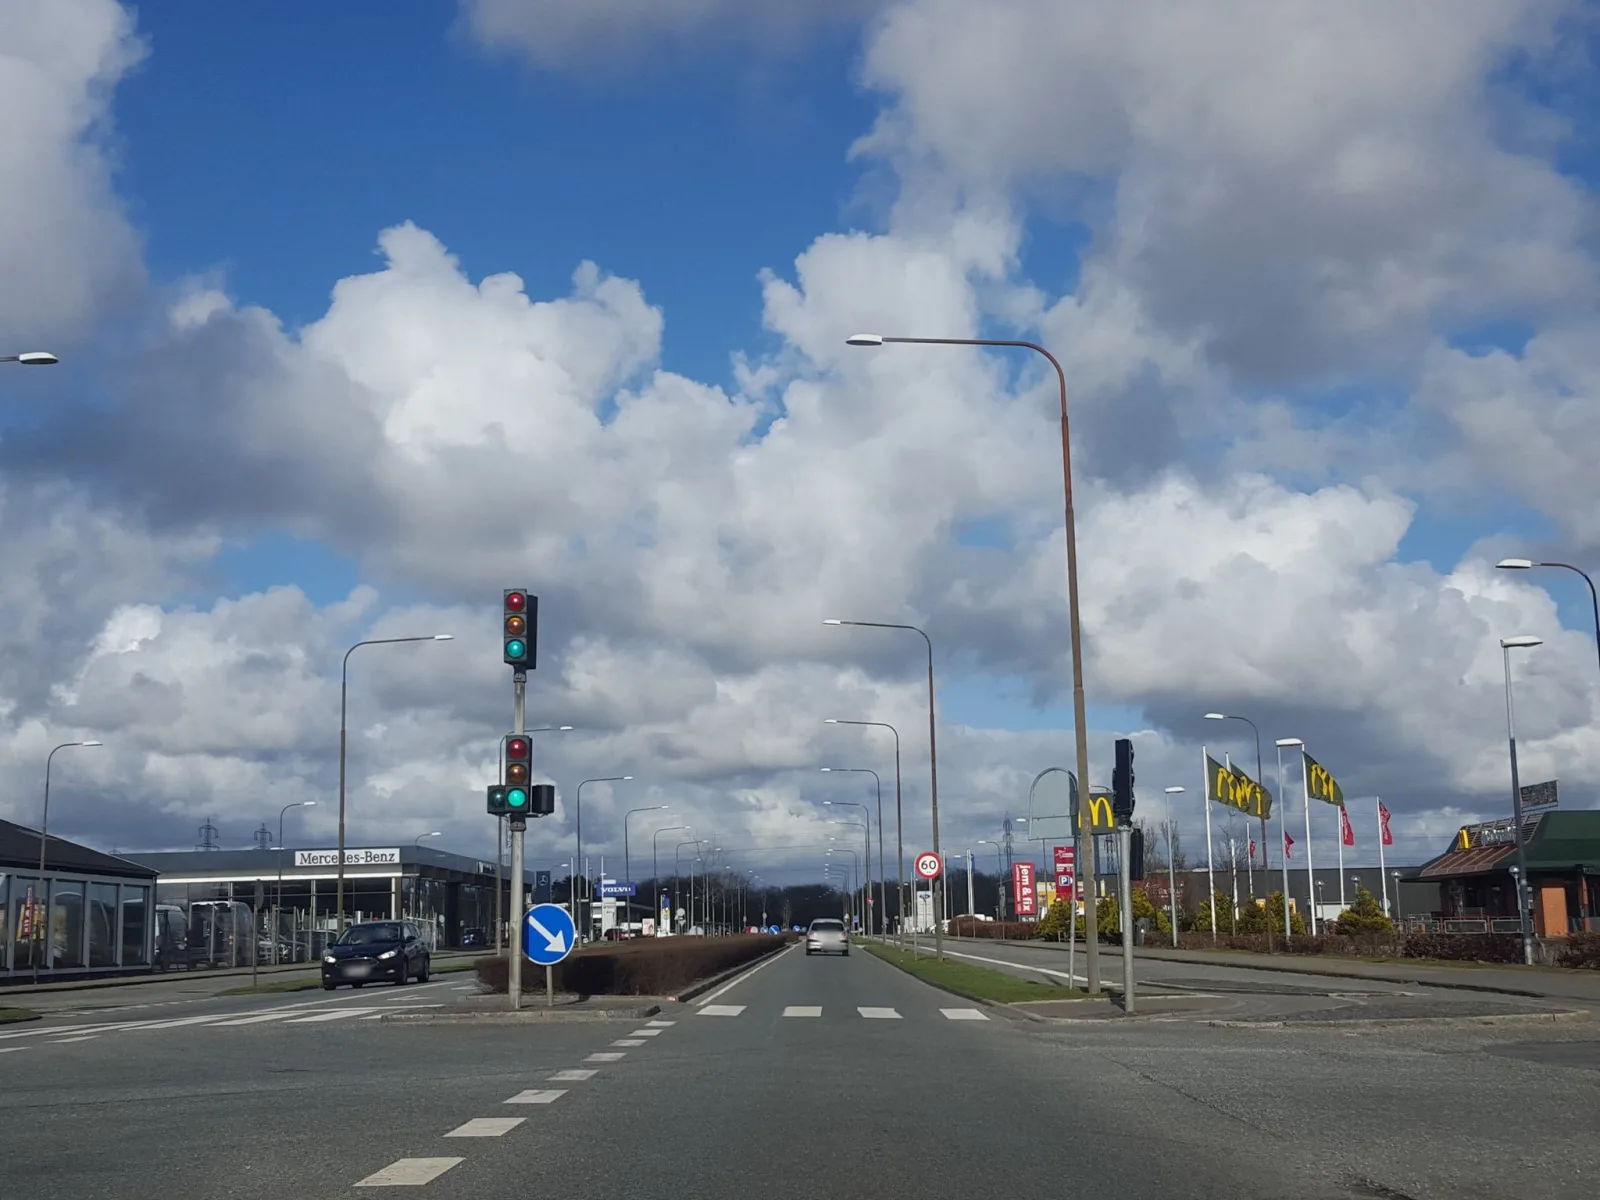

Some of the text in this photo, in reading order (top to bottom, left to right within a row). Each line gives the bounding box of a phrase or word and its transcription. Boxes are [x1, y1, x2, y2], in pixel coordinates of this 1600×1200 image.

[921, 860, 936, 870] 60
[1019, 864, 1031, 886] jem
[1021, 886, 1032, 896] &
[1022, 896, 1033, 911] fix
